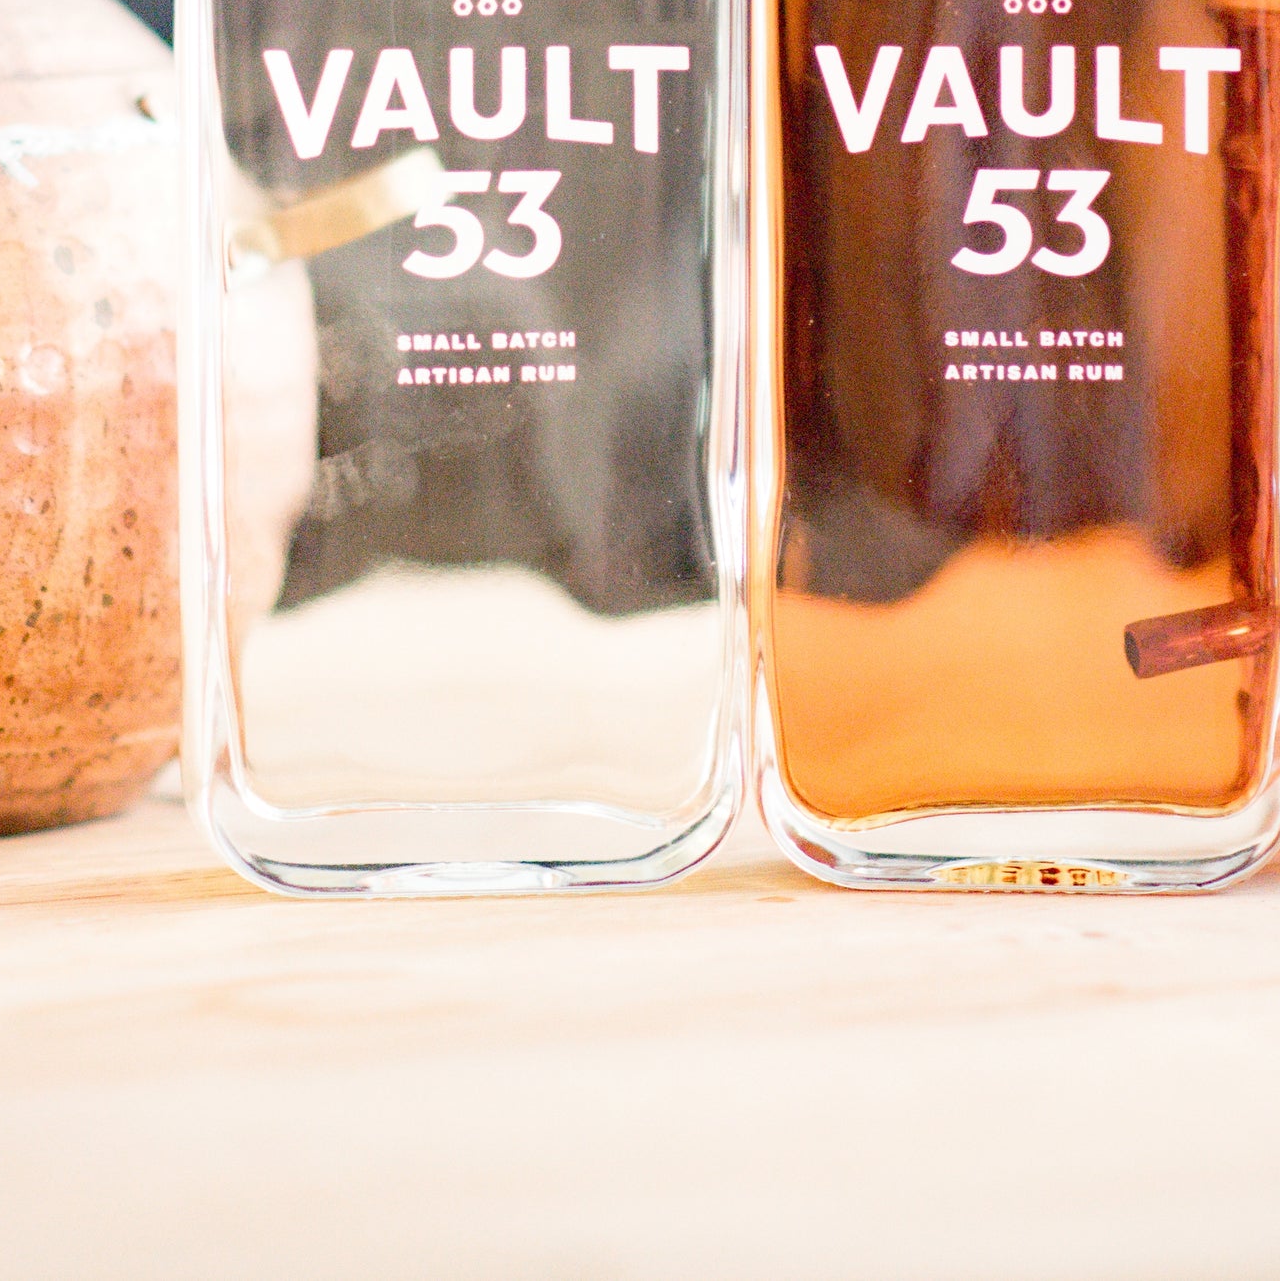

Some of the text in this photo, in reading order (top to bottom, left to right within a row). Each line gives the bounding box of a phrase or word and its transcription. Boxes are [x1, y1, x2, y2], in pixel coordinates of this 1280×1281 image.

[262, 44, 691, 160] VAULT
[814, 45, 1242, 155] VAULT
[401, 169, 563, 280] 53
[950, 168, 1112, 277] 53
[396, 330, 576, 352] SMALL BATCH
[944, 331, 1124, 348] SMALL BATCH
[396, 364, 577, 385] ARTISAN RUM
[944, 364, 1124, 381] ARTISAN RUM
